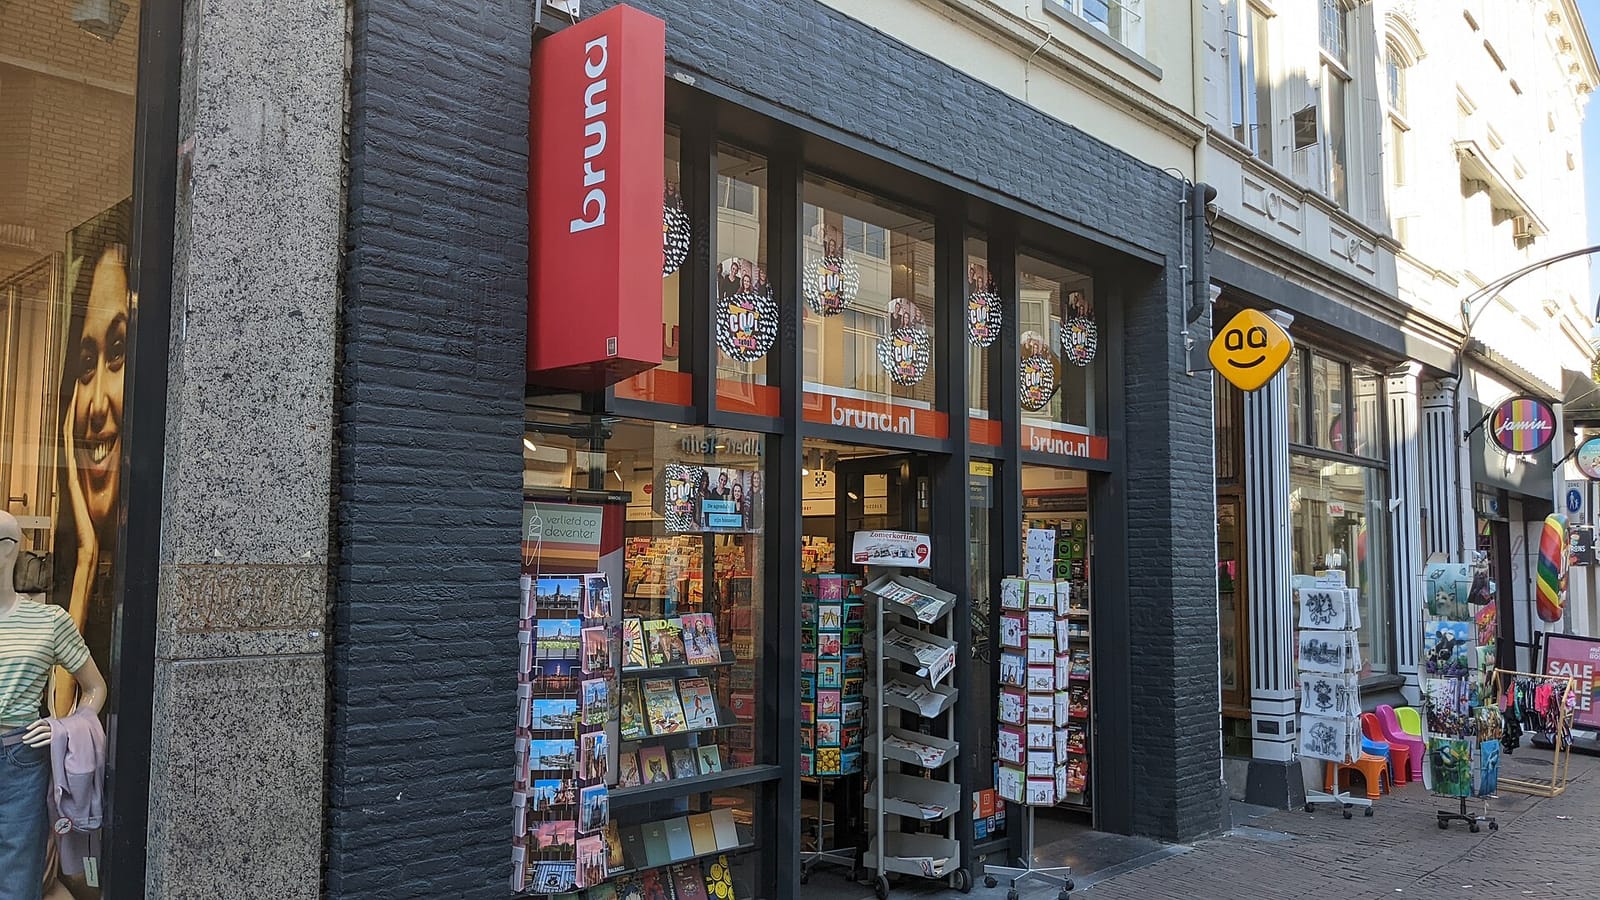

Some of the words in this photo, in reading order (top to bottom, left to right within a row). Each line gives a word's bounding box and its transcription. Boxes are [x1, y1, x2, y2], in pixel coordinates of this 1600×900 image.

[570, 35, 608, 233] bruna
[831, 397, 915, 434] bruna.nl
[1495, 417, 1552, 437] jamin
[1030, 428, 1089, 458] bruna.nl
[544, 525, 596, 538] deventer
[583, 520, 597, 528] op
[1549, 660, 1593, 679] SALE
